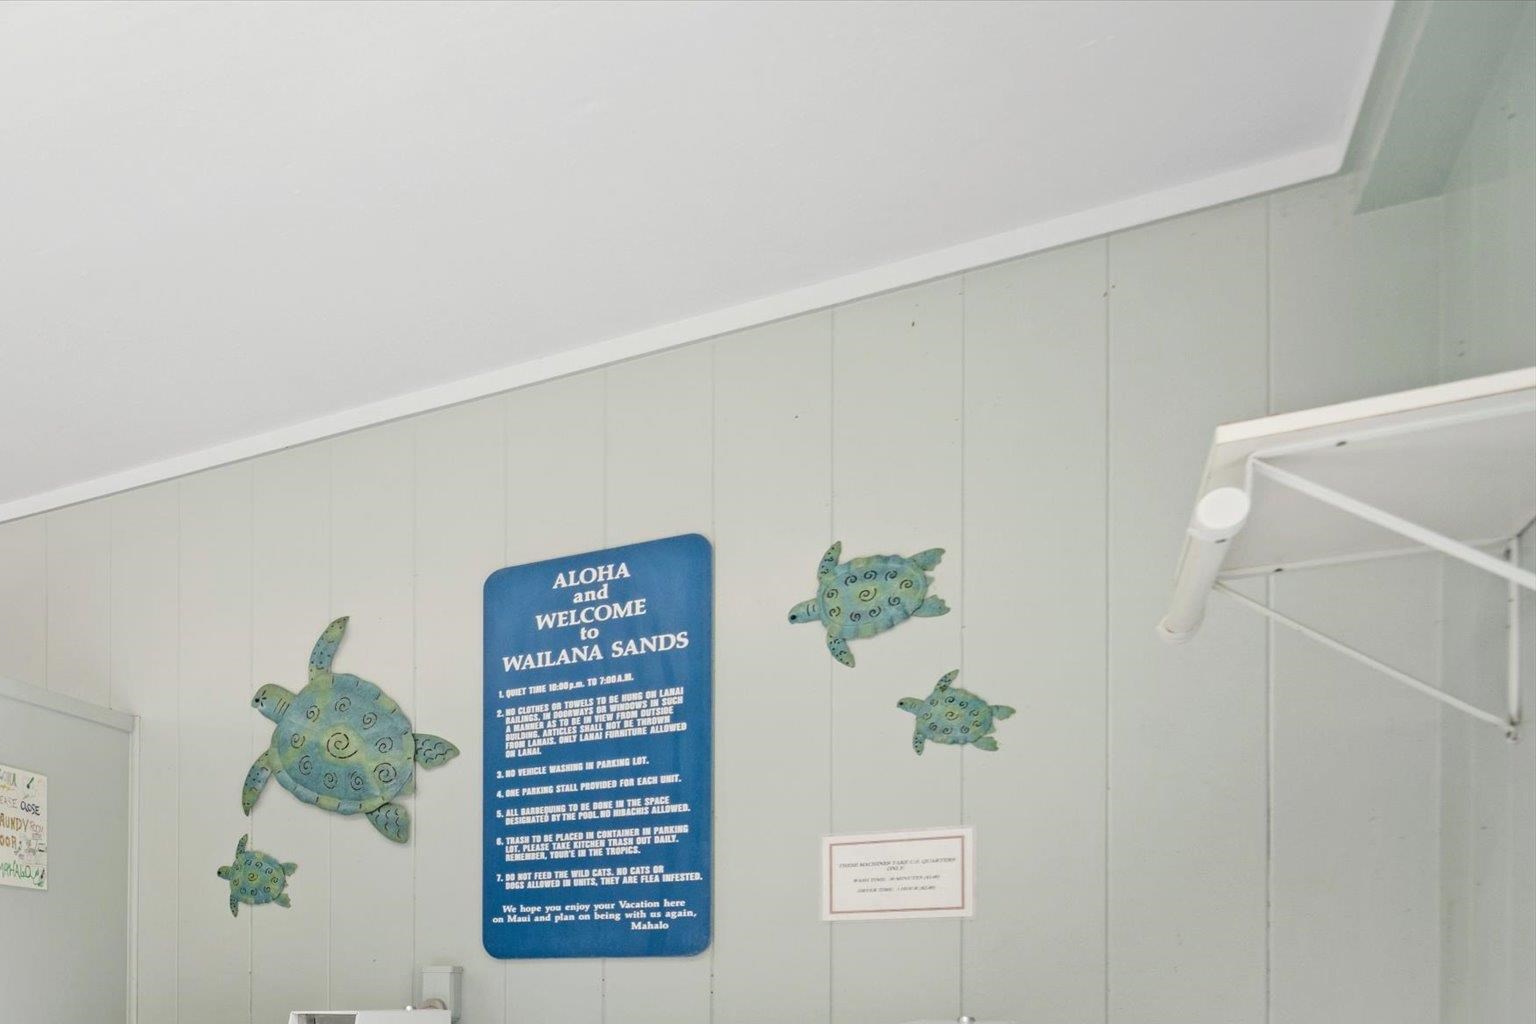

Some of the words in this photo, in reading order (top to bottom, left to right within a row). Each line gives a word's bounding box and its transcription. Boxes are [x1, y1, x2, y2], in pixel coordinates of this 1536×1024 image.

[552, 560, 630, 589] ALOHA
[573, 583, 608, 603] and
[535, 597, 646, 631] WELCOME
[580, 625, 598, 640] to
[502, 642, 603, 672] WAILANA
[611, 630, 688, 658] SANDS
[499, 690, 503, 698] 1.
[506, 687, 526, 698] QUIET
[528, 684, 546, 694] TIME
[587, 677, 596, 686] TO
[496, 709, 503, 717] 2.
[505, 707, 515, 716] NO
[517, 703, 549, 715] CLOTHES
[551, 701, 561, 710] OR
[564, 698, 593, 709] TOWELS
[596, 696, 606, 705] TO
[608, 694, 618, 703] BE
[621, 691, 642, 702] HUNG
[645, 689, 656, 699] ON
[659, 686, 683, 698] LANAI
[542, 712, 550, 720] IN
[553, 706, 593, 719] DOORWAYS
[596, 705, 606, 713] OR
[609, 699, 647, 712] WINDOWS
[650, 698, 658, 707] IN
[661, 695, 682, 706] SUCH
[505, 730, 539, 741] BUILDING.
[542, 725, 576, 737] ARTICLES
[579, 722, 603, 733] SHALL
[605, 720, 620, 729] NOT
[624, 719, 633, 728] BE
[636, 715, 670, 726] THROWN
[513, 720, 543, 732] MANNER
[546, 719, 556, 728] AS
[559, 718, 568, 726] TO
[571, 716, 580, 725] BE
[583, 715, 591, 724] IN
[594, 712, 613, 722] VIEW
[616, 710, 637, 720] FROM
[640, 705, 673, 717] OUTSIDE
[505, 740, 525, 749] FROM
[527, 736, 555, 747] LANAIS.
[559, 734, 577, 743] ONLY
[579, 731, 602, 741] LANAI
[605, 726, 646, 738] FURNITURE
[650, 722, 686, 734] ALLOWED
[505, 749, 515, 757] ON
[496, 770, 503, 778] 3.
[505, 769, 515, 777] NO
[518, 766, 546, 776] VEHICLE
[549, 762, 582, 773] WASHING
[585, 761, 593, 769] IN
[596, 758, 629, 768] PARKING
[632, 755, 648, 765] LOT.
[505, 788, 519, 797] ONE
[522, 785, 553, 795] PARKING
[556, 783, 577, 792] STALL
[580, 779, 616, 790] PROVIDED
[619, 778, 634, 787] FOR
[637, 776, 657, 785] EACH
[660, 774, 680, 783] UNIT.
[20, 801, 41, 816] CLOSE
[505, 814, 549, 825] DESIGNATED
[551, 813, 560, 821] BY
[562, 812, 575, 820] THE
[600, 809, 610, 817] NO
[613, 806, 648, 816] HIBACHIS
[651, 803, 690, 813] ALLOWED.
[506, 808, 518, 816] ALL
[521, 804, 565, 816] BARBEQUING
[568, 803, 577, 811] TO
[580, 802, 589, 810] BE
[593, 800, 612, 809] DONE
[627, 798, 641, 807] THE
[644, 796, 669, 805] SPACE
[496, 837, 503, 845] 6.
[506, 836, 529, 844] TRASH
[543, 834, 552, 842] BE
[555, 832, 583, 841] PLACED
[586, 831, 593, 839] IN
[596, 828, 639, 838] CONTAINER
[642, 827, 650, 835] IN
[653, 824, 688, 834] PARKING
[505, 844, 519, 853] LOT.
[523, 843, 548, 852] PLEASE
[552, 841, 570, 850] TAKE
[573, 839, 605, 848] KITCHEN
[607, 837, 633, 846] TRASH
[636, 836, 651, 844] OUT
[654, 834, 678, 843] DAILY.
[550, 849, 574, 858] YOUR'E
[588, 847, 602, 856] THE
[605, 845, 640, 855] TROPICS.
[505, 873, 515, 881] DO
[517, 872, 531, 880] NOT
[534, 871, 551, 879] FEED
[554, 870, 568, 878] THE
[571, 869, 589, 877] WILD
[592, 868, 613, 876] CATS.
[616, 867, 627, 875] NO
[630, 866, 650, 874] CATS
[653, 865, 663, 873] OR
[505, 881, 524, 889] DOGS
[527, 879, 560, 888] ALLOWED
[600, 876, 619, 884] THEY
[622, 875, 637, 883] ARE
[640, 874, 659, 882] FLEA
[662, 872, 702, 881] INFESTED.
[507, 914, 530, 922] Maui
[534, 913, 550, 921] and
[555, 912, 574, 922] plan
[594, 911, 620, 921] being
[625, 910, 645, 918] with
[665, 909, 696, 919] again,
[520, 904, 540, 913] hope
[565, 902, 589, 912] enjoy
[619, 899, 659, 908] Vacation
[664, 898, 685, 906] here
[631, 921, 668, 929] Mahalo
